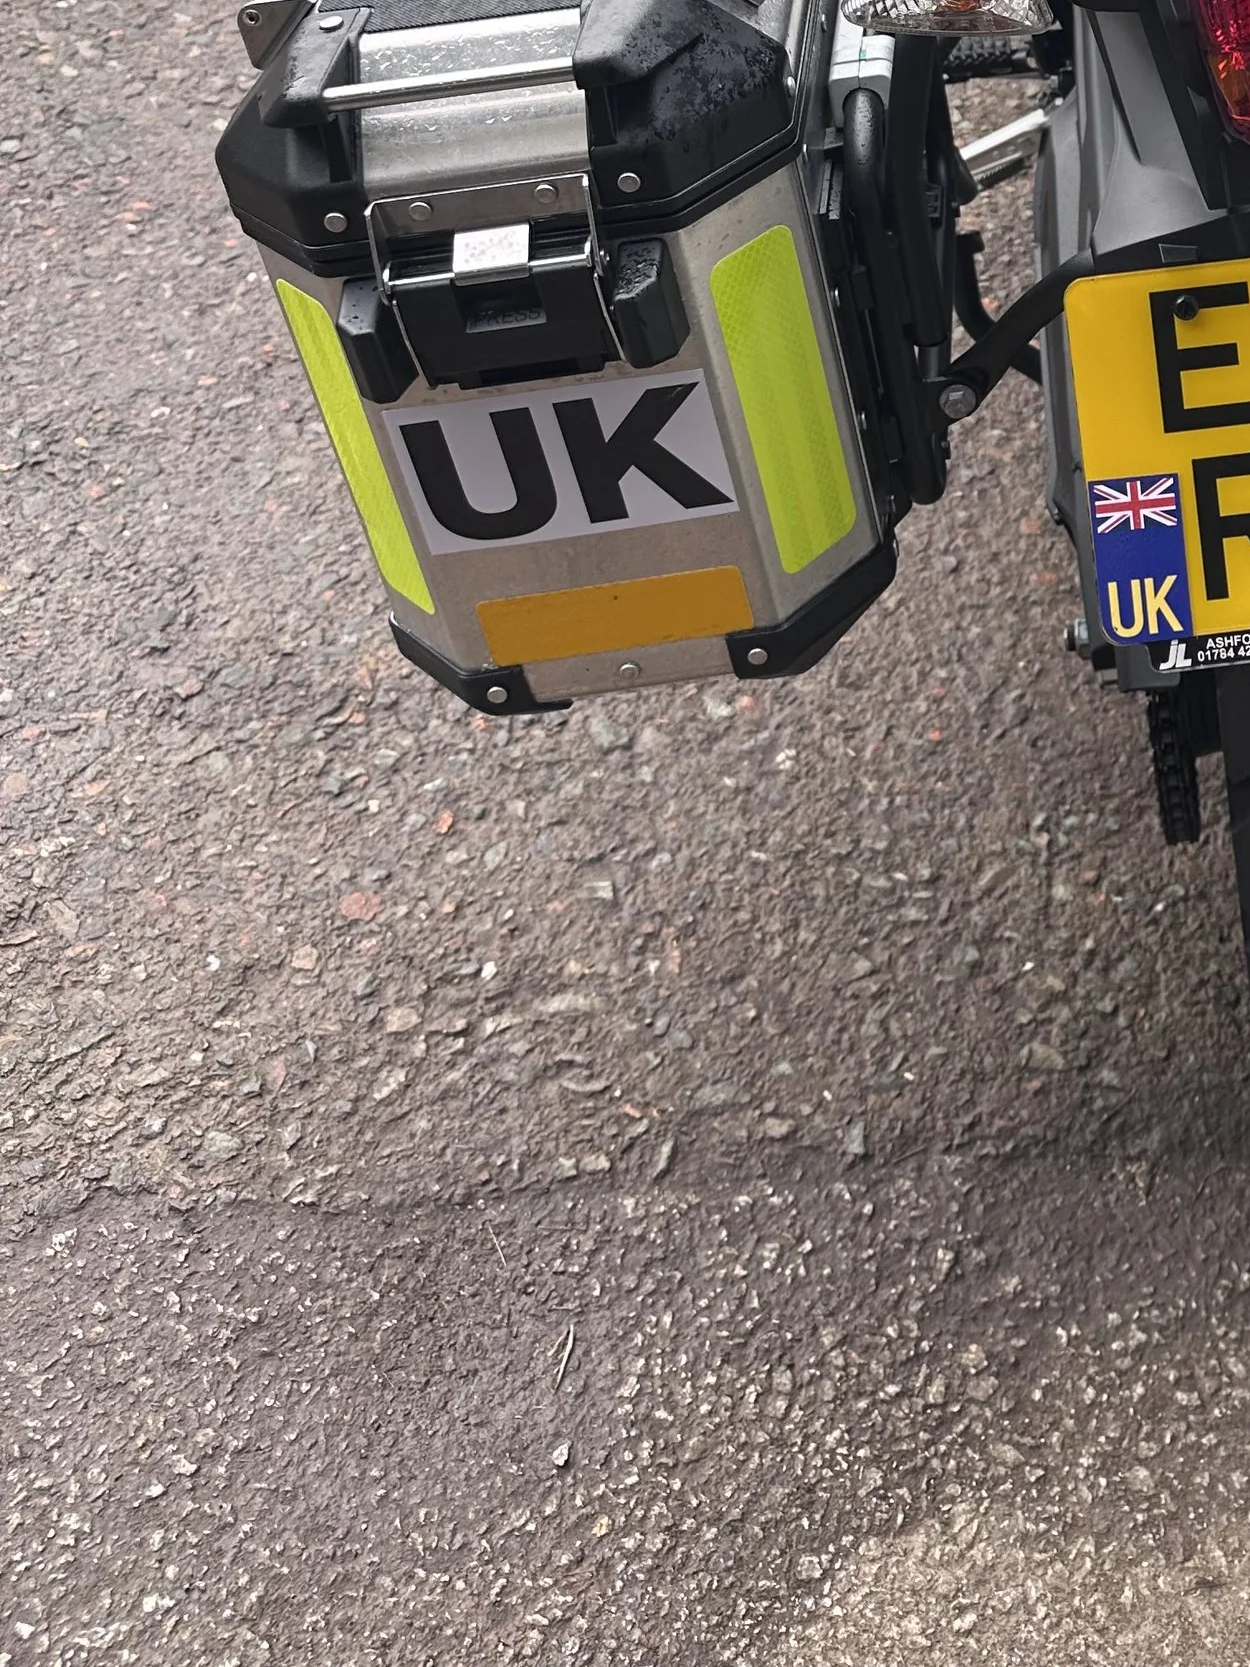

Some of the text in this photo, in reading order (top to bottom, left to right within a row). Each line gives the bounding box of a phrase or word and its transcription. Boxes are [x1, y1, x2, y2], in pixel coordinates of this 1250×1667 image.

[474, 308, 542, 329] PRESS
[398, 381, 734, 541] UK
[1108, 574, 1184, 638] UK
[1197, 647, 1235, 663] 01784
